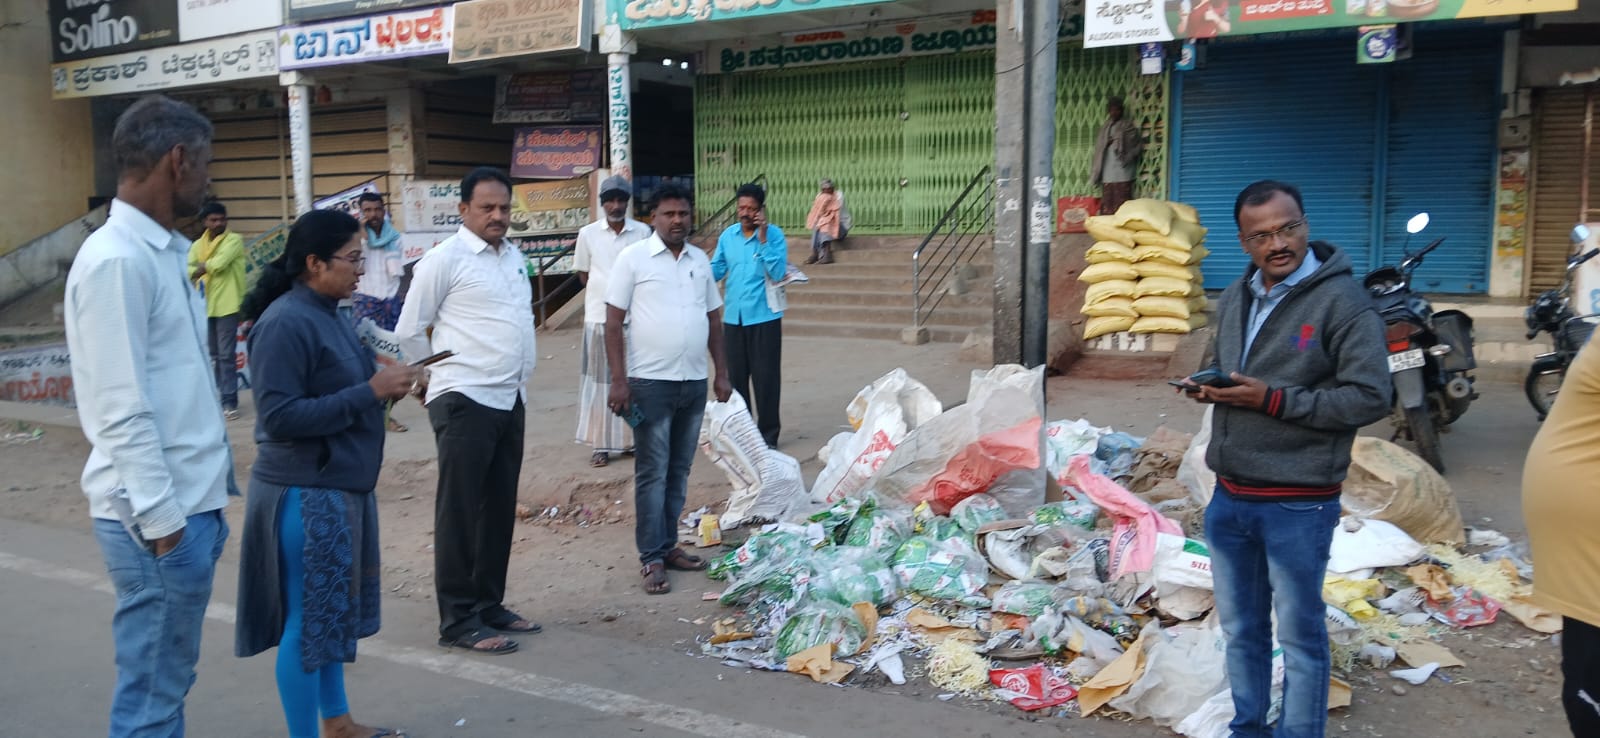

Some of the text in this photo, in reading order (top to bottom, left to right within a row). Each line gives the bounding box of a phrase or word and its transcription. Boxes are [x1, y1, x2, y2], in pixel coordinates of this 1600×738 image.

[59, 4, 138, 54] Solino
[1088, 28, 1161, 41] ALISON STORES
[72, 55, 148, 91] ಪ್ರಕಾಶ್
[719, 47, 745, 73] ಶ್ರೀ
